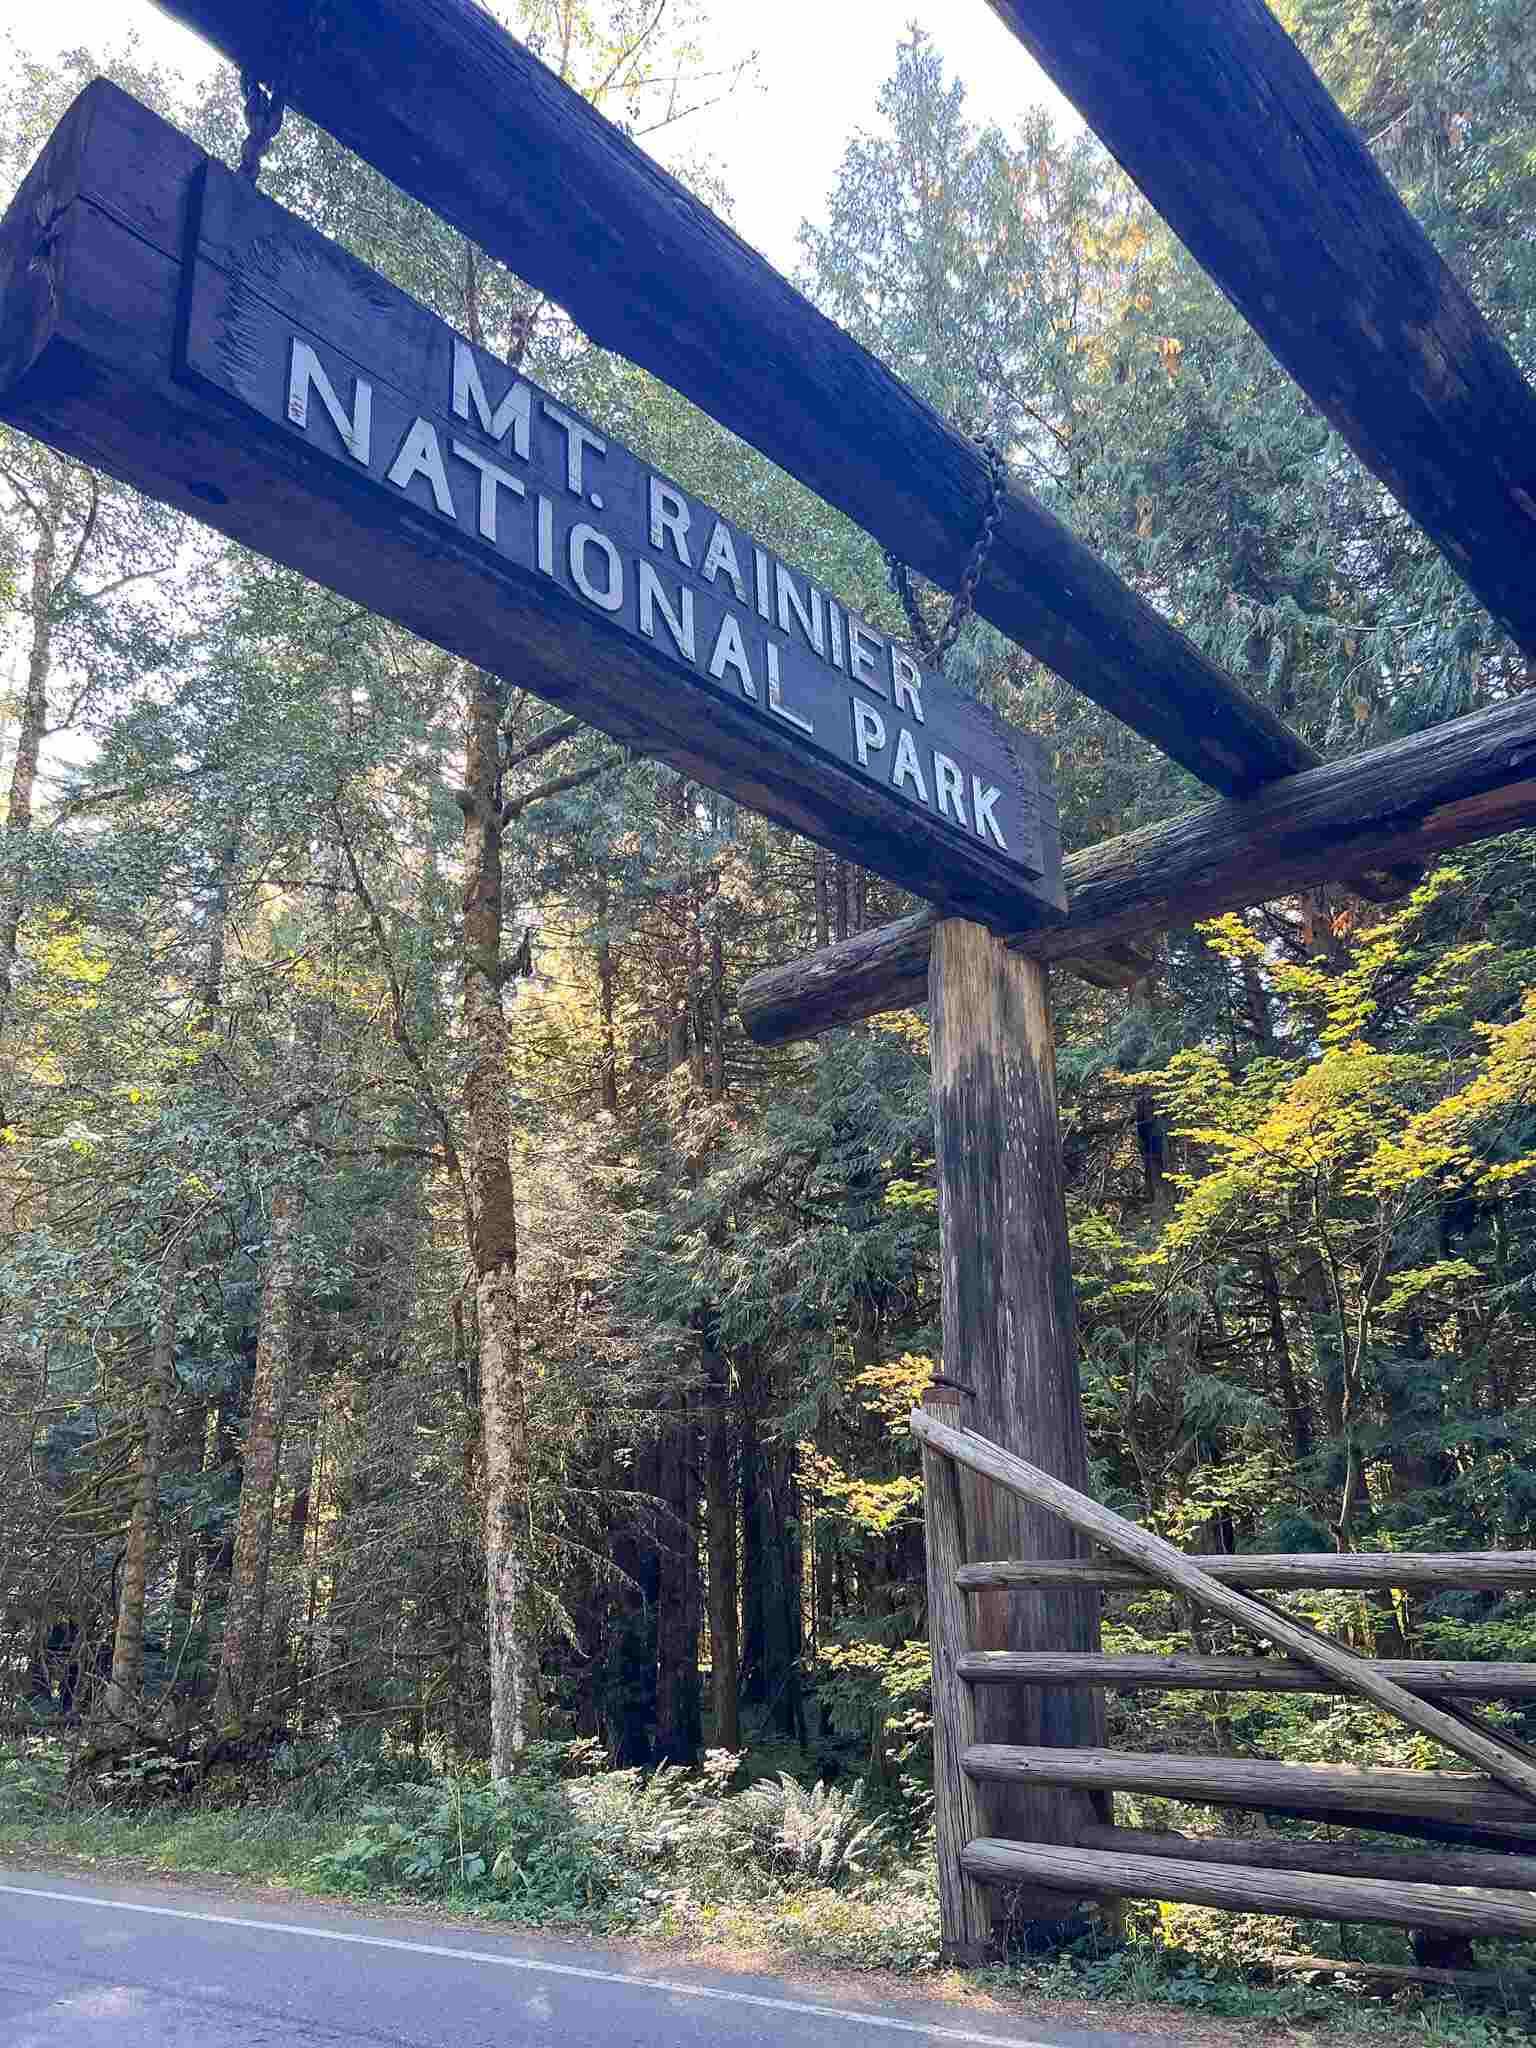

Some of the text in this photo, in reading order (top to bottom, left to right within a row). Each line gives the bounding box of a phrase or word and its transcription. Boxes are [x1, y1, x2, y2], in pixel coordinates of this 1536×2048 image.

[287, 336, 1008, 851] NATIONAL PARK
[453, 336, 924, 724] MT. RAINIER
